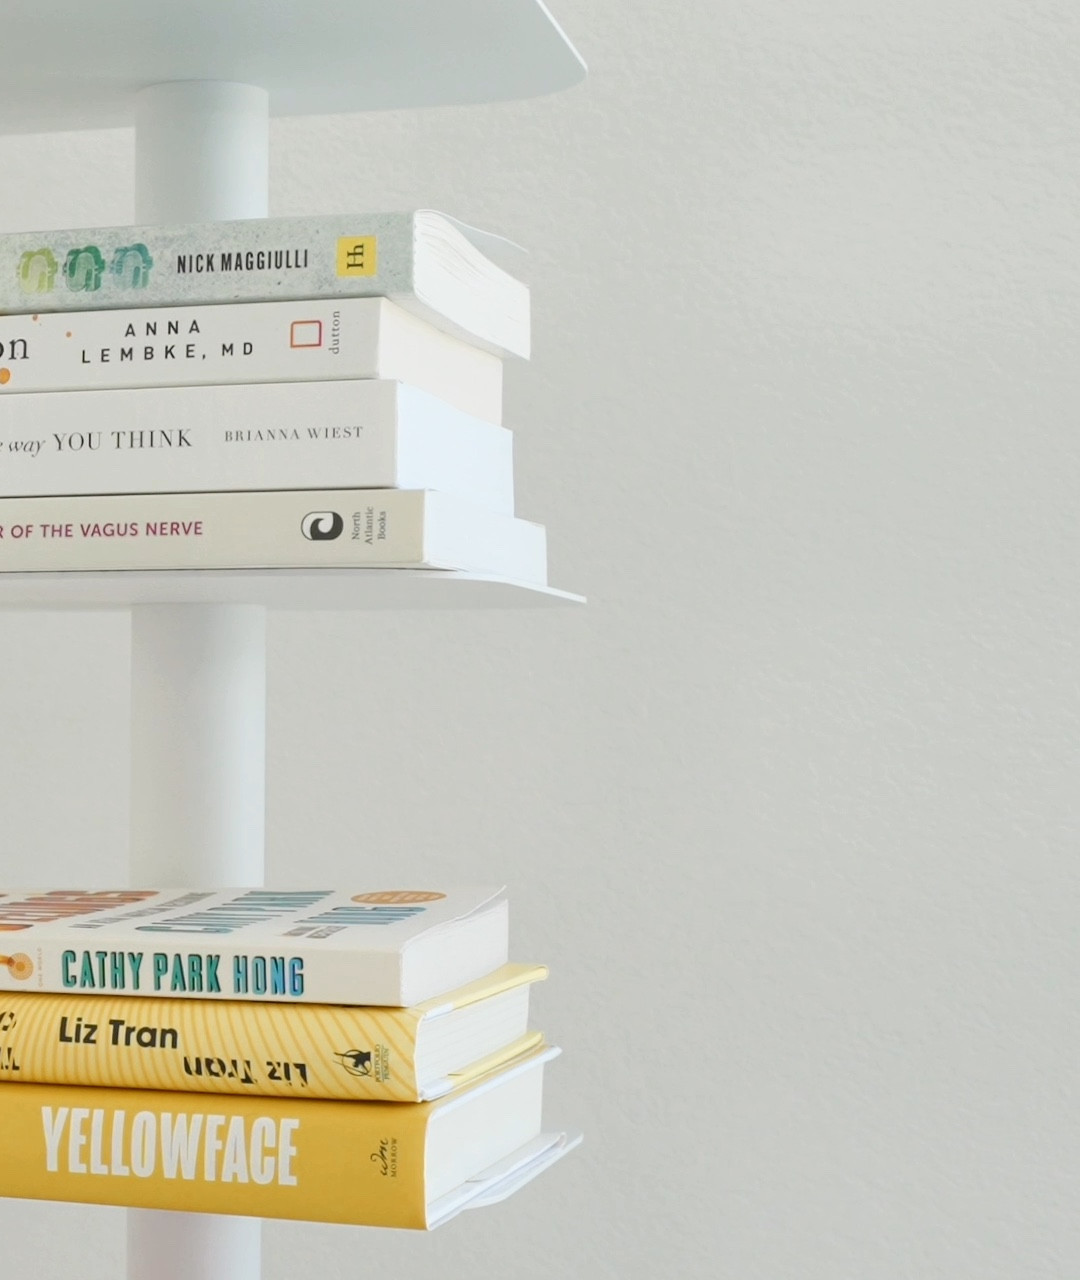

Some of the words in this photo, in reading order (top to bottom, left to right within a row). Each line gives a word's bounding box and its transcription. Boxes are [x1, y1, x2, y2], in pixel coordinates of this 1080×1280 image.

[176, 252, 216, 274] NICK
[220, 248, 310, 272] MAGGIULLI
[124, 319, 201, 338] ANNA
[328, 310, 341, 355] dutton
[81, 343, 207, 364] LEMBKE,
[221, 342, 254, 358] MD
[8, 439, 46, 458] way
[53, 431, 102, 452] YOU
[111, 428, 193, 450] THINK
[224, 427, 301, 442] BRIANNA
[307, 425, 364, 439] WIEST
[10, 524, 34, 539] OF
[39, 523, 74, 538] THE
[80, 521, 139, 537] VAGUS
[145, 520, 204, 536] NERVE
[352, 511, 360, 540] North
[61, 949, 143, 989] CATHY
[154, 953, 221, 993] PARK
[233, 955, 304, 996] HONG
[58, 1016, 98, 1045] Liz
[108, 1018, 179, 1049] Tran
[41, 1105, 300, 1187] YELLOWFACE
